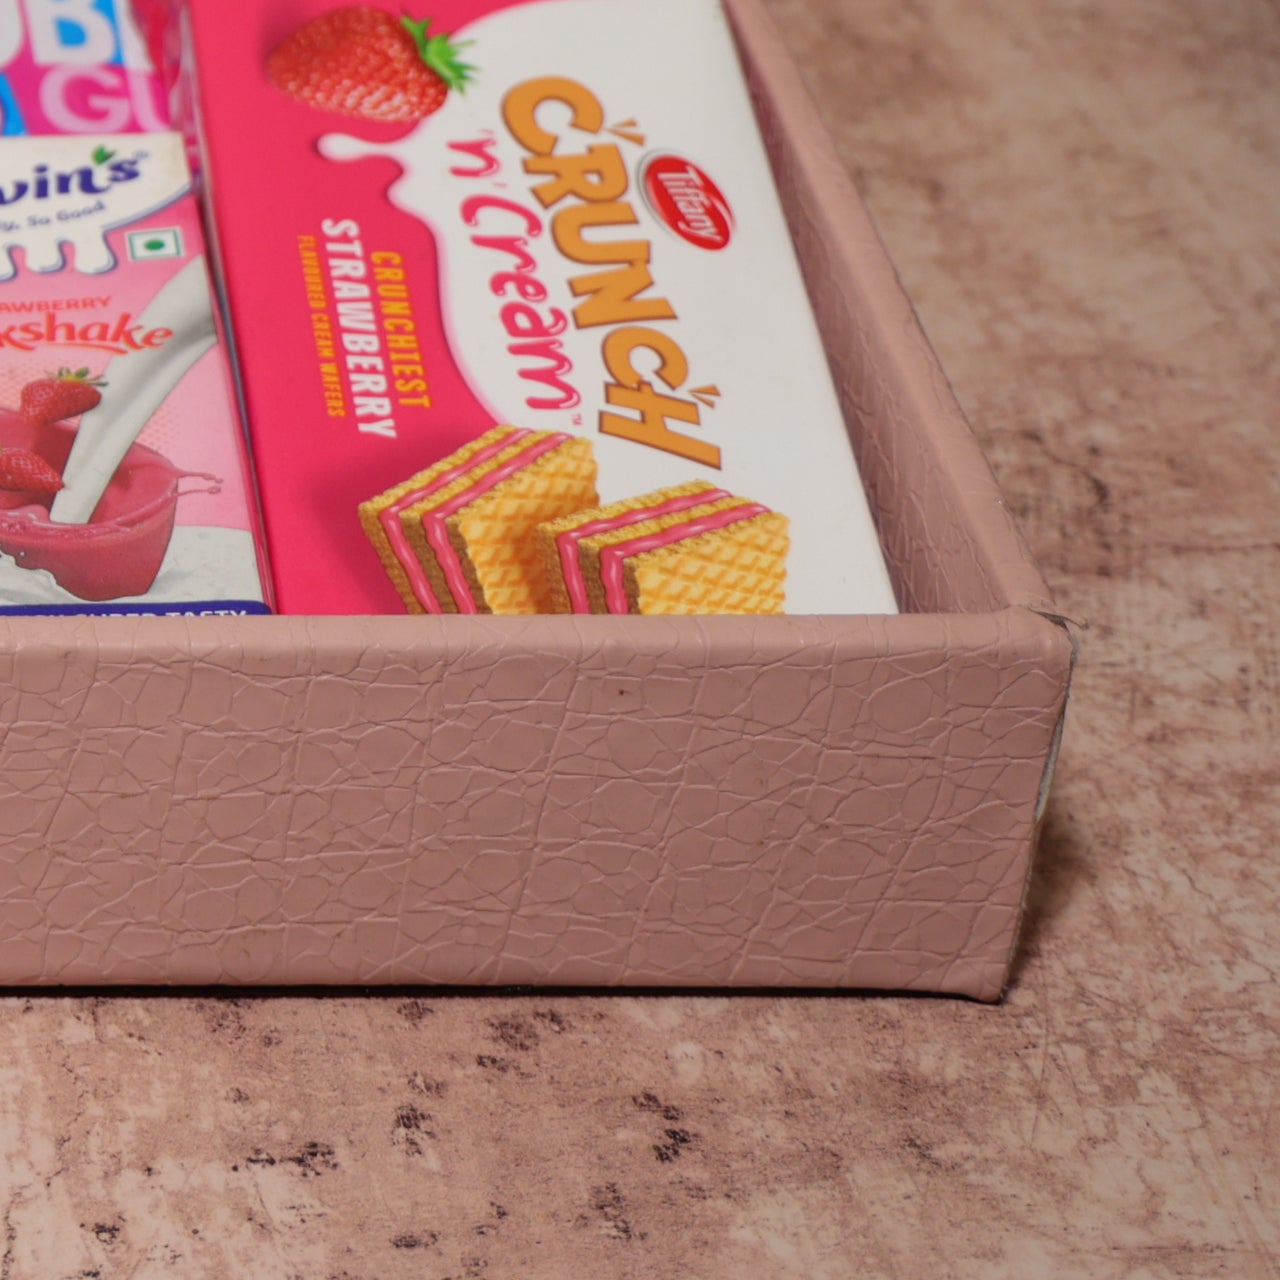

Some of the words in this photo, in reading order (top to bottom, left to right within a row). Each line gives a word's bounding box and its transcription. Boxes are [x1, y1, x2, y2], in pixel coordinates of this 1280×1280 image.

[296, 233, 325, 310] FLAVOURED
[310, 312, 336, 360] CREAM
[320, 218, 398, 439] STRAWBERRY
[371, 249, 431, 409] CRUNCHIEST
[459, 193, 583, 411] Cream
[499, 74, 724, 472] CRUNCH
[320, 362, 346, 418] WAFERS
